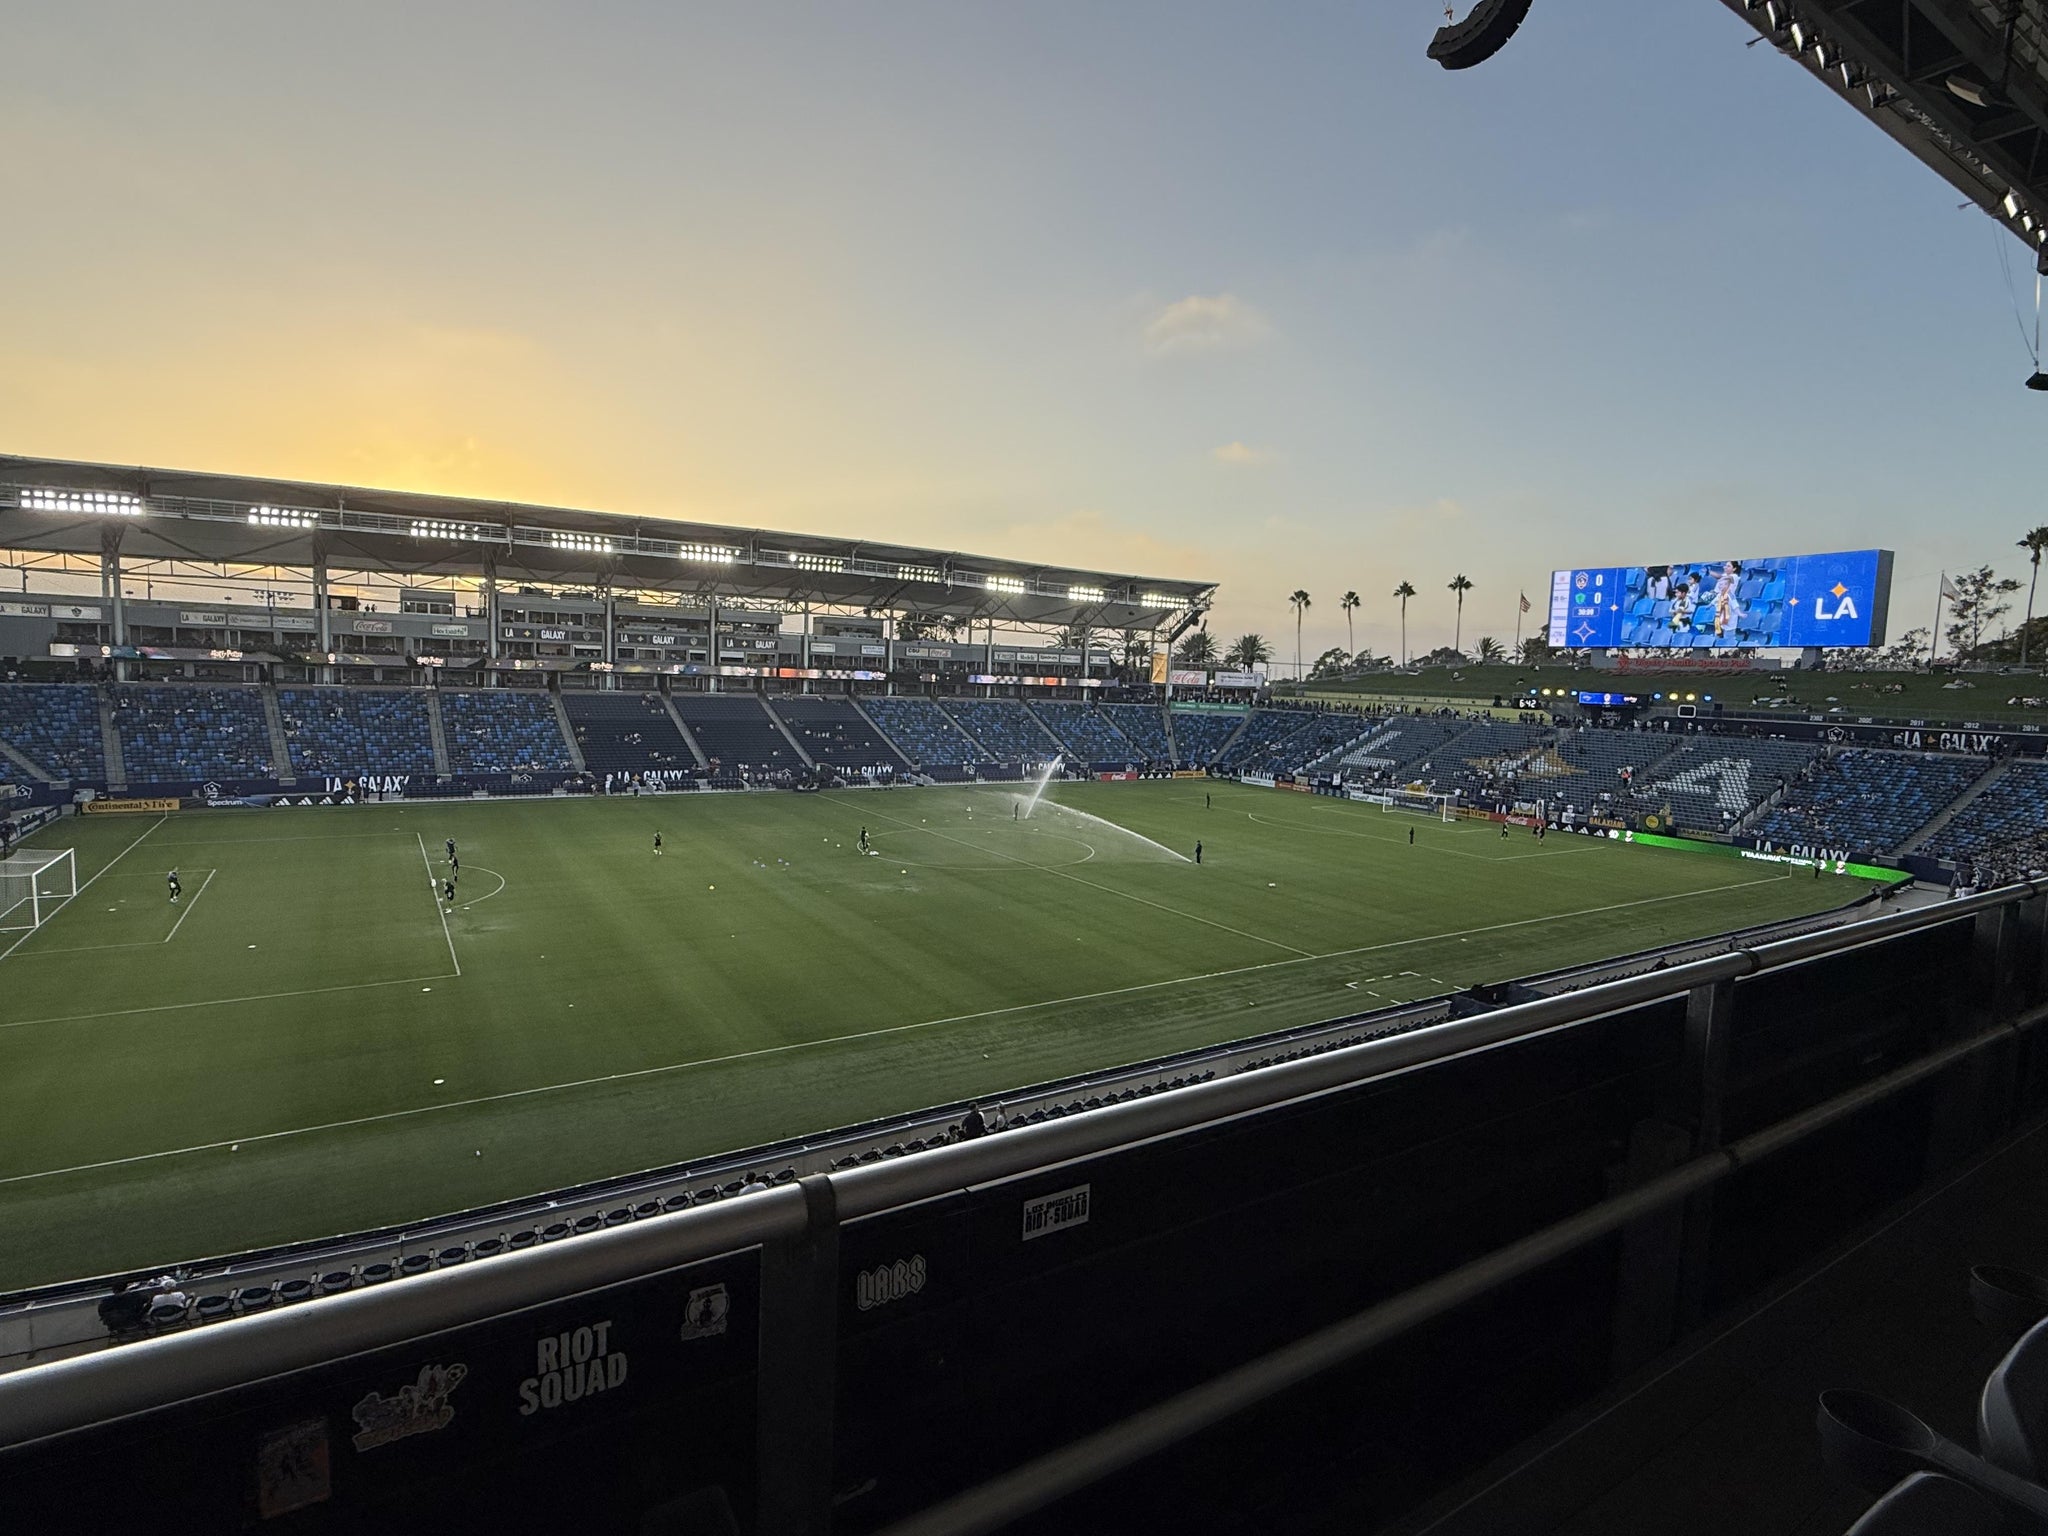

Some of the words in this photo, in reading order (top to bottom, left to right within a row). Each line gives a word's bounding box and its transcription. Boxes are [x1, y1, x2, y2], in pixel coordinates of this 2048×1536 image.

[1595, 574, 1603, 587] 0
[1594, 592, 1602, 605] 0
[21, 606, 47, 614] GALAXY
[1815, 597, 1858, 620] LA
[505, 628, 514, 638] LA
[541, 629, 566, 640] GALAXY
[620, 634, 629, 643] LA
[653, 635, 676, 645] GALAXY
[726, 639, 735, 648] LA
[755, 640, 777, 650] GALAXY
[325, 777, 342, 793] LA
[358, 775, 410, 794] GALAXY
[207, 798, 243, 807] Spectrum
[857, 1255, 926, 1310] LARS
[537, 1320, 613, 1376] RIOT
[519, 1351, 628, 1416] SQUAD
